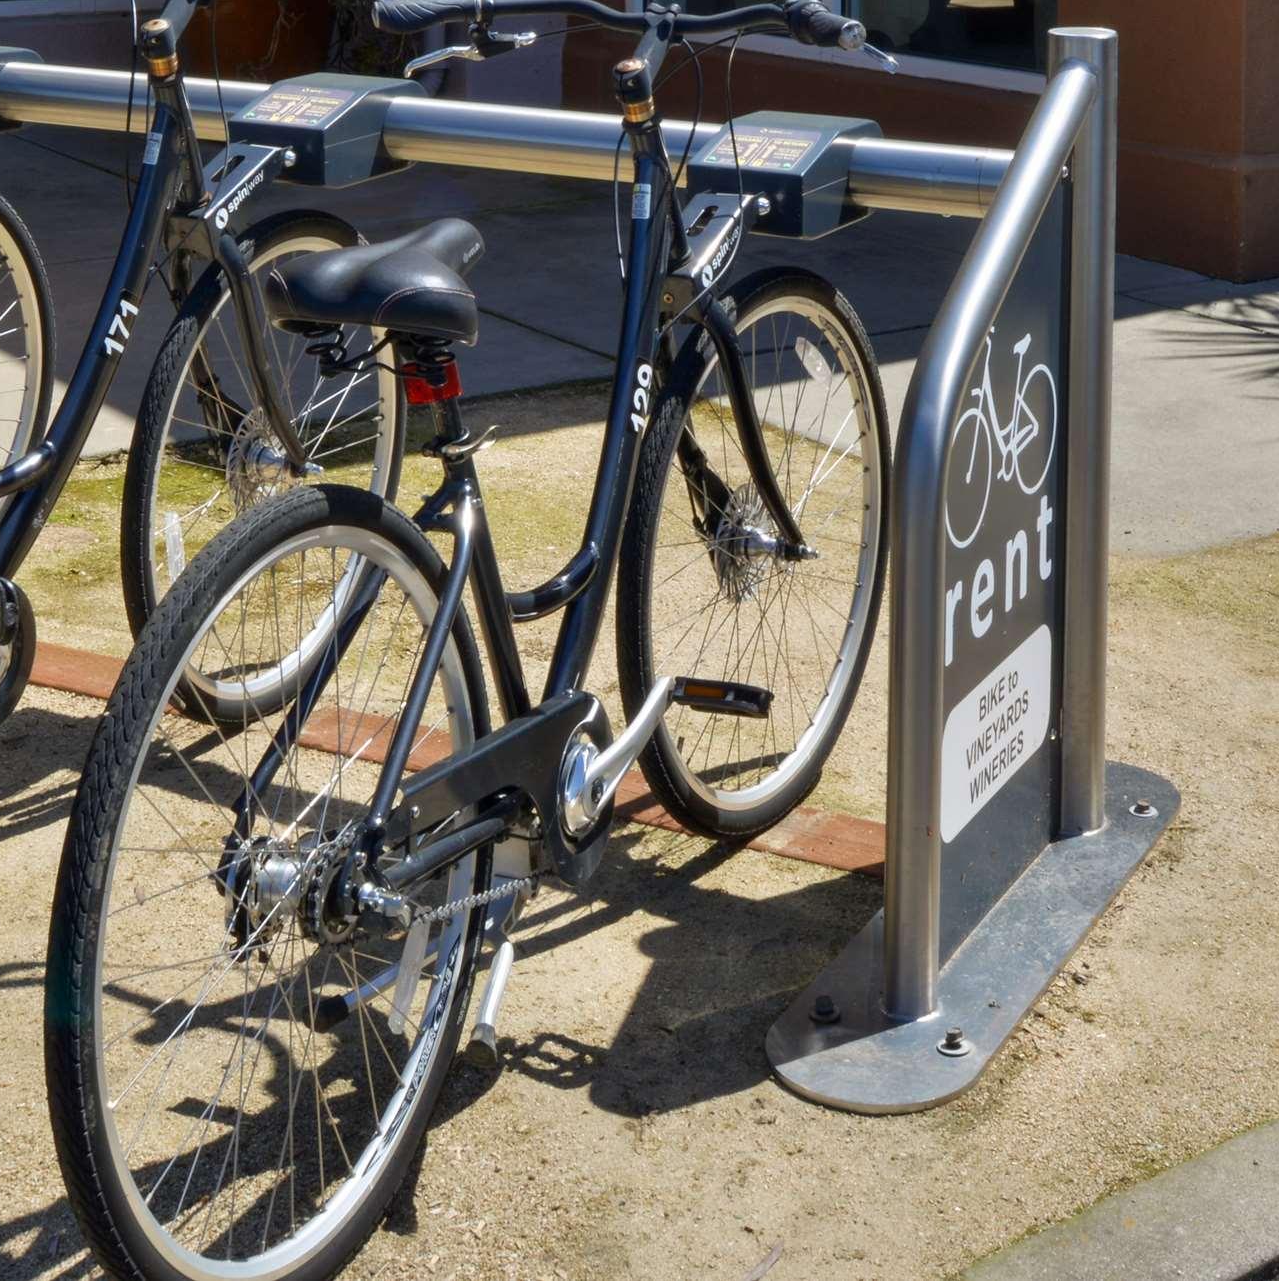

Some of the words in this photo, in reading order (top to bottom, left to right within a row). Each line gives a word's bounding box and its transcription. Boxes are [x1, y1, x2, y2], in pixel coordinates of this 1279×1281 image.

[104, 299, 139, 356] 171
[944, 494, 1053, 668] rent
[965, 690, 1030, 770] VINEYARDS
[978, 681, 1006, 722] BIKE
[1007, 670, 1019, 692] to
[970, 730, 1025, 804] WINERIES
